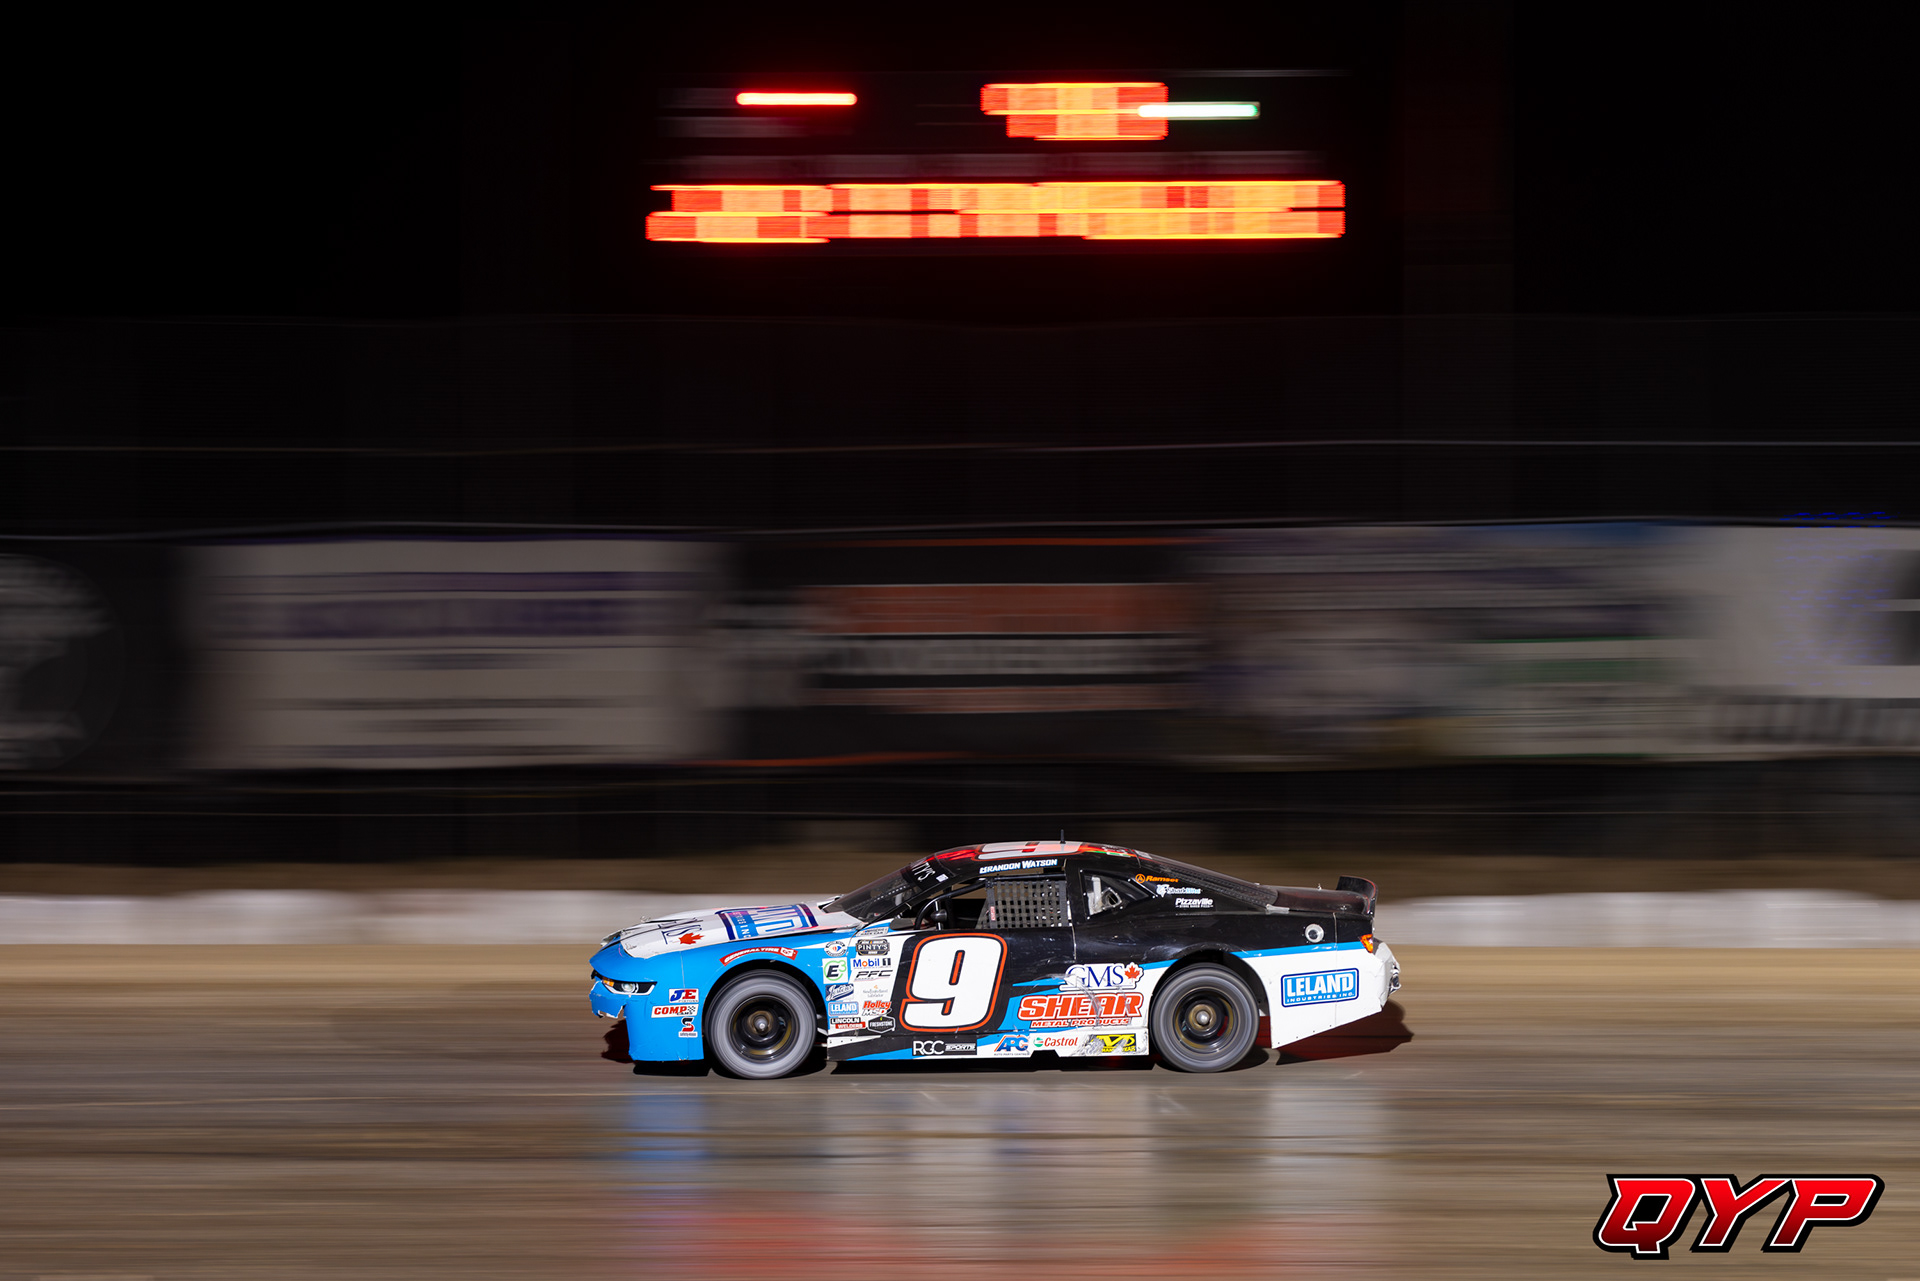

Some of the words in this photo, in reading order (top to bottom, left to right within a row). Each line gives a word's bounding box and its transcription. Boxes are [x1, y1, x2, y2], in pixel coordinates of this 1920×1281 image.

[979, 862, 1020, 874] BRANDON
[1022, 859, 1058, 869] WATSON
[1175, 897, 1214, 905] Pizzaville
[857, 943, 888, 951] PINTY'S
[724, 948, 760, 963] GENERAL
[853, 958, 880, 968] Mobil
[883, 958, 891, 966] 1
[856, 969, 893, 978] PFC
[1068, 964, 1124, 987] GMS
[903, 936, 1003, 1029] 9
[1286, 973, 1354, 997] LELAND
[670, 989, 697, 1002] JE
[1286, 994, 1337, 1003] INDUSTRIES
[831, 1003, 857, 1012] LELAND
[863, 1000, 892, 1010] Holley
[1019, 995, 1142, 1019] SHEAR
[654, 1006, 688, 1015] COMP
[1071, 1019, 1130, 1027] PRODUCTS
[995, 1035, 1029, 1052] APC
[1044, 1037, 1079, 1047] Castrol
[913, 1040, 945, 1055] RGC
